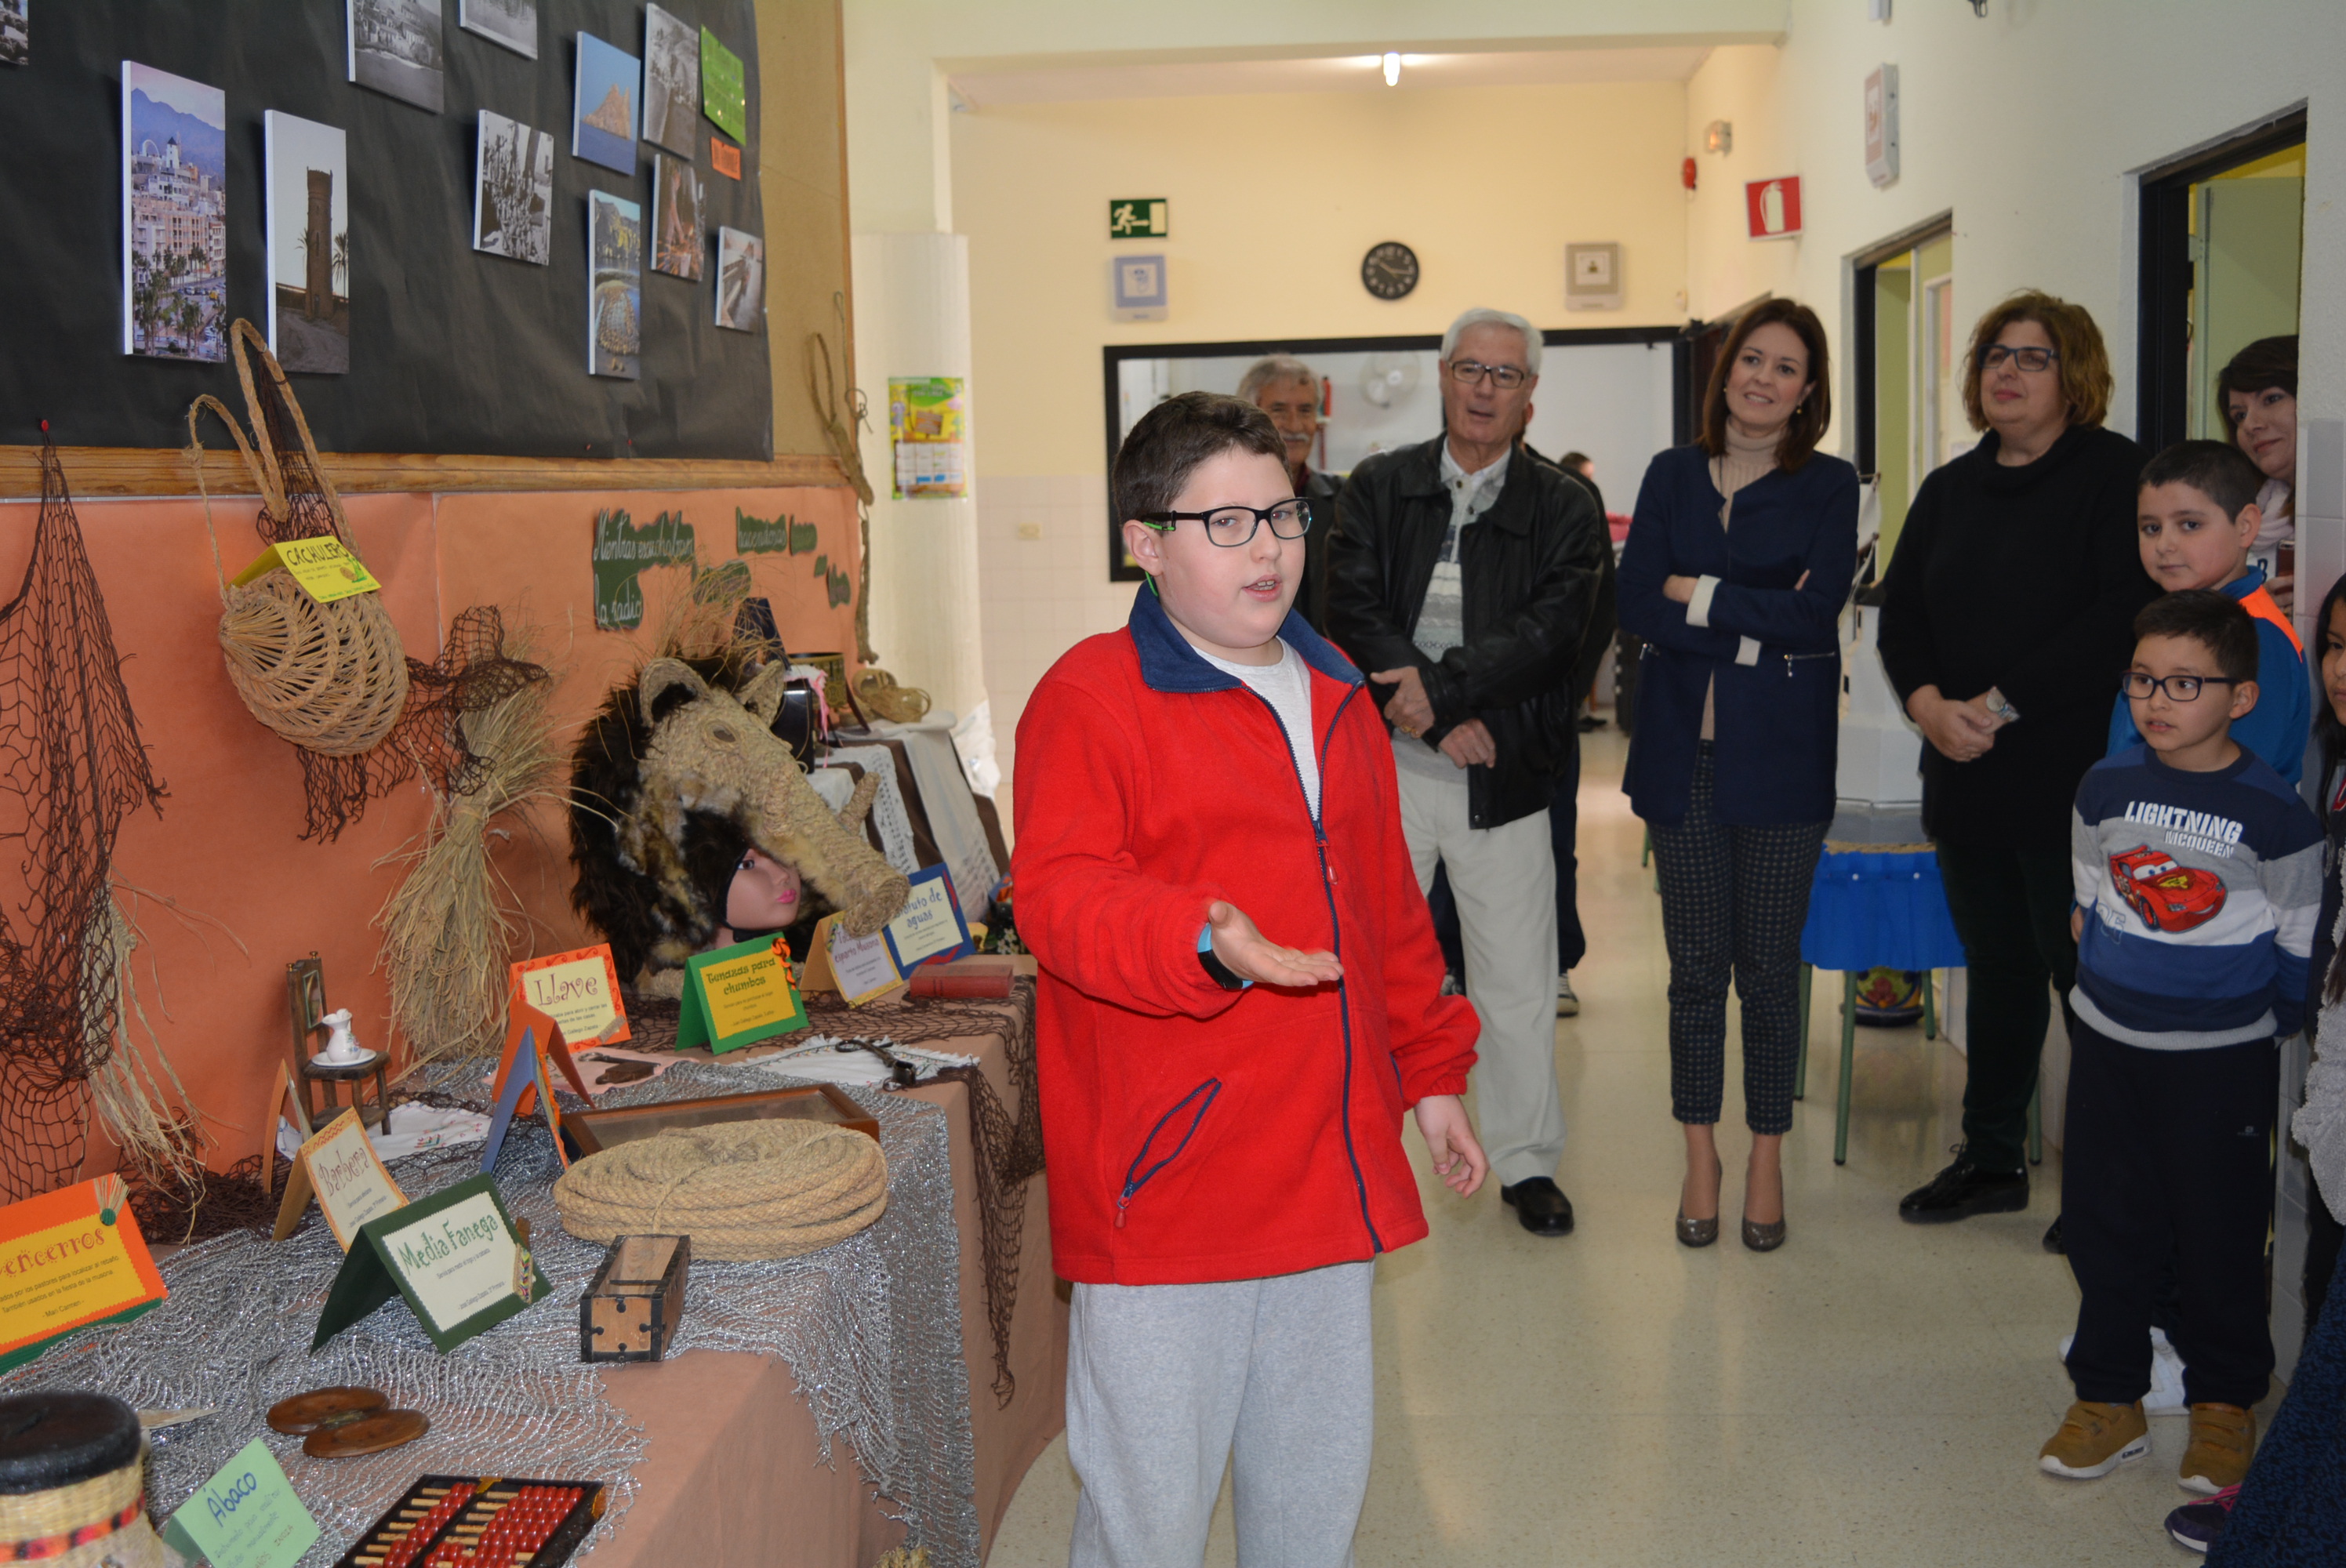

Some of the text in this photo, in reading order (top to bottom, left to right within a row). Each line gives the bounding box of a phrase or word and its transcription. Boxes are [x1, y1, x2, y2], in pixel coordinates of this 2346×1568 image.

[595, 573, 608, 624] la
[612, 580, 642, 622] radio
[2124, 800, 2242, 844] LIGHTNING
[2165, 830, 2235, 858] MCQUEEN
[929, 887, 942, 903] de
[906, 909, 933, 930] aguas
[706, 957, 775, 984] Tenazas para
[534, 972, 598, 1006] Llave
[724, 976, 766, 995] chumbos
[0, 1229, 104, 1277] encerros
[398, 1218, 499, 1276] Media Fanega
[34, 1277, 58, 1290] pastores
[58, 1272, 71, 1282] para
[72, 1263, 93, 1277] localizar
[27, 1294, 47, 1305] usados
[62, 1283, 78, 1292] fiesta
[203, 1472, 257, 1528] Ábaco
